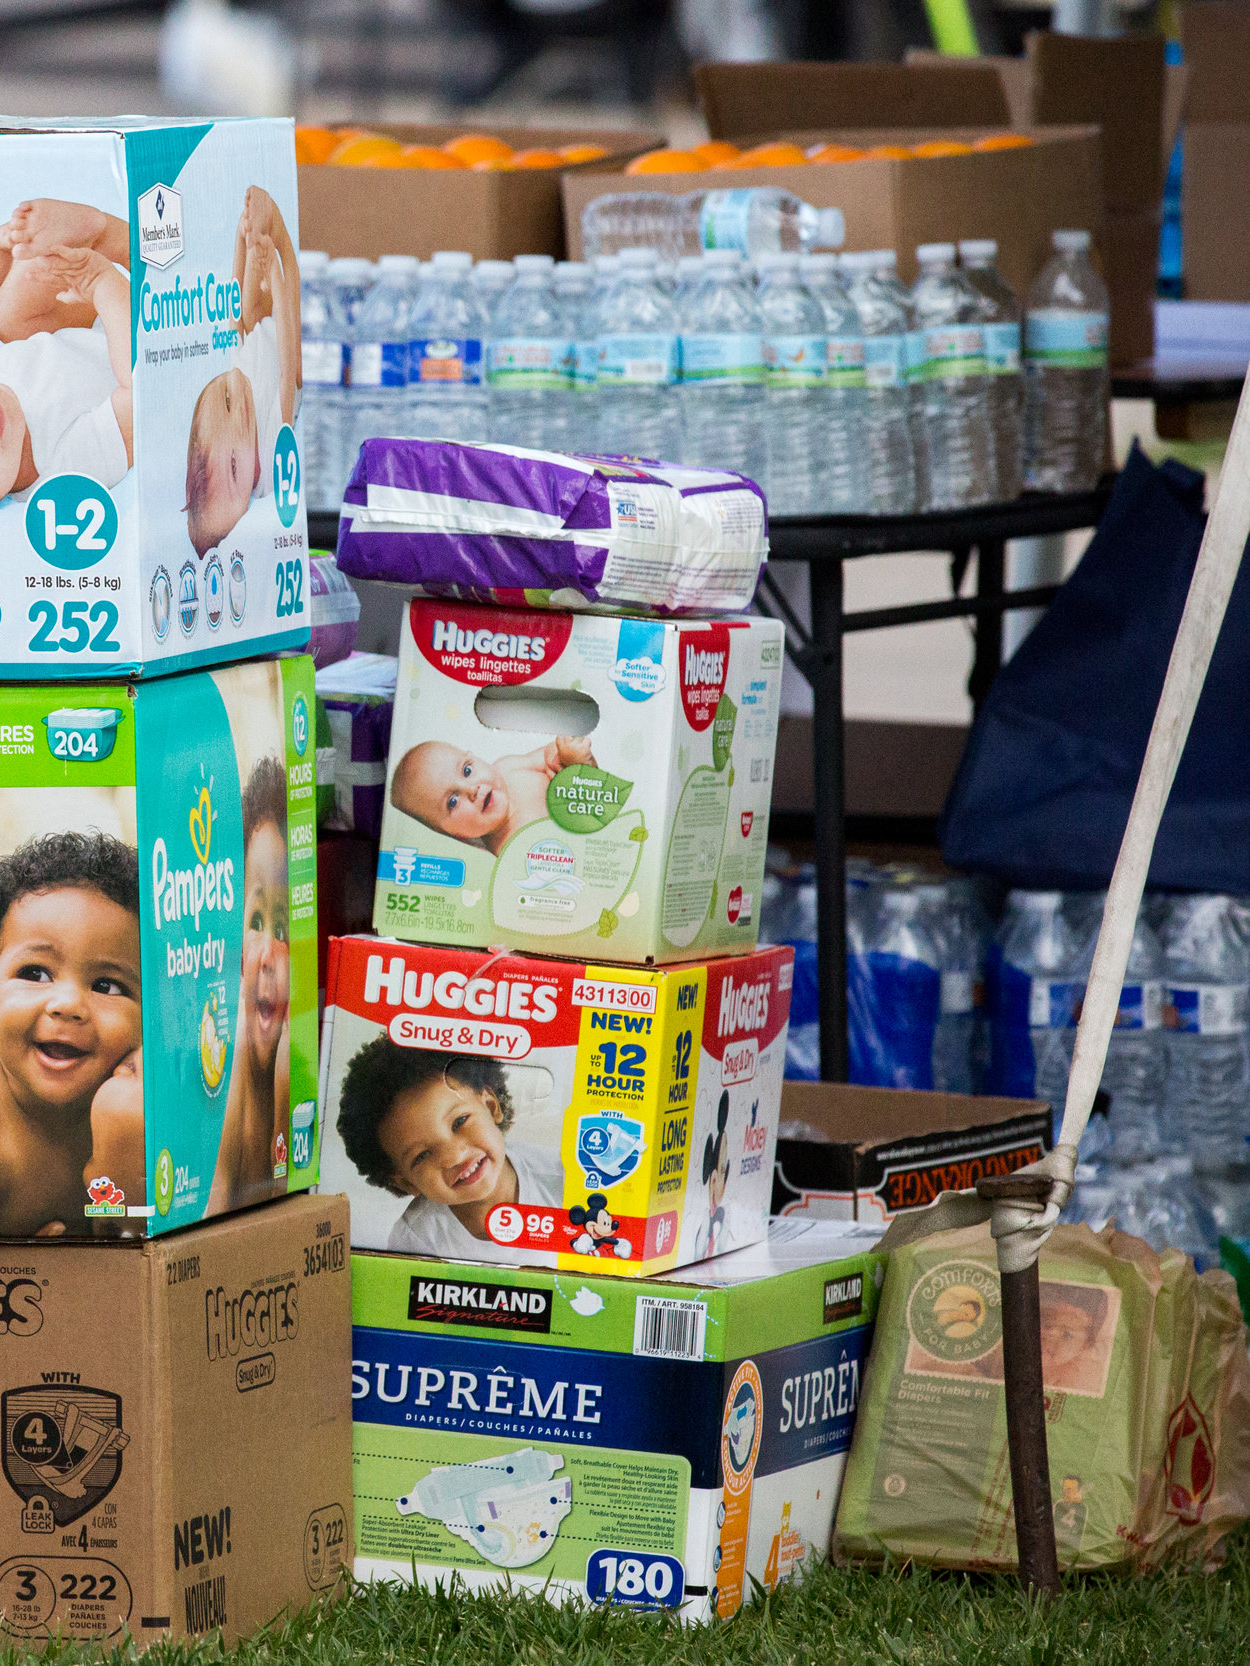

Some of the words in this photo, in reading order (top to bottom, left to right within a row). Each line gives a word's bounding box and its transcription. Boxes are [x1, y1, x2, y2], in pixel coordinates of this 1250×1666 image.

[141, 274, 203, 332] Comfort
[205, 273, 241, 323] Care
[37, 498, 107, 550] 1-2
[25, 576, 53, 589] 12-18
[55, 576, 75, 589] lbs.
[78, 576, 101, 590] (5-8
[103, 576, 121, 590] kg)
[276, 558, 303, 618] 252
[28, 599, 120, 653] 252
[432, 620, 546, 662] HUGGIES
[441, 654, 475, 669] wipes
[480, 656, 531, 674] lingettes
[621, 669, 658, 681] Sensitive
[625, 662, 650, 672] Softer
[685, 644, 724, 686] HUGGIES
[467, 670, 502, 683] toallitas
[54, 730, 99, 757] 204
[289, 763, 312, 786] HOURS
[572, 776, 603, 788] HUGGIES
[556, 784, 618, 804] natural
[568, 800, 604, 816] care
[539, 846, 565, 854] SOFTER
[152, 837, 234, 931] Pampers
[398, 869, 408, 883] 3
[386, 893, 421, 912] 552
[167, 938, 201, 978] baby
[203, 932, 224, 973] dry
[364, 955, 558, 1023] HUGGIES
[503, 972, 528, 980] DIAPERS
[532, 975, 559, 984] PAÑALES
[574, 984, 650, 1008] 4311300
[677, 982, 698, 1011] NEW!
[717, 975, 770, 1038] HUGGIES
[400, 1020, 453, 1047] Snug
[458, 1028, 473, 1045] &
[591, 1012, 653, 1035] NEW!
[599, 1042, 647, 1077] 12
[676, 1029, 692, 1081] 12
[586, 1088, 644, 1101] PROTECTION
[587, 1075, 645, 1093] HOUR
[668, 1085, 688, 1104] HOUR
[589, 1131, 602, 1146] 4
[661, 1116, 686, 1152] LONG
[659, 1155, 684, 1177] LASTING
[888, 1159, 983, 1208] ORANGE
[499, 1210, 512, 1227] 5
[527, 1214, 554, 1234] 96
[417, 1282, 546, 1314] KIRKLAND
[825, 1275, 862, 1306] KIRKLAND
[416, 1303, 545, 1327] Signature
[680, 1303, 704, 1311] 958184
[205, 1282, 299, 1362] HUGGIES
[41, 1372, 81, 1384] WITH
[900, 1379, 971, 1398] Comfortable
[974, 1388, 990, 1399] Fit
[351, 1360, 602, 1424] SUPRÊME
[24, 1418, 47, 1445] 4
[21, 1445, 52, 1455] Layers
[584, 1460, 611, 1468] Breathable
[25, 1512, 51, 1520] LEAK
[26, 1521, 51, 1529] LOCK
[174, 1506, 231, 1571] NEW!
[16, 1571, 36, 1601] 3
[60, 1574, 116, 1600] 222
[599, 1557, 673, 1598] 180
[70, 1612, 105, 1620] PAÑALES
